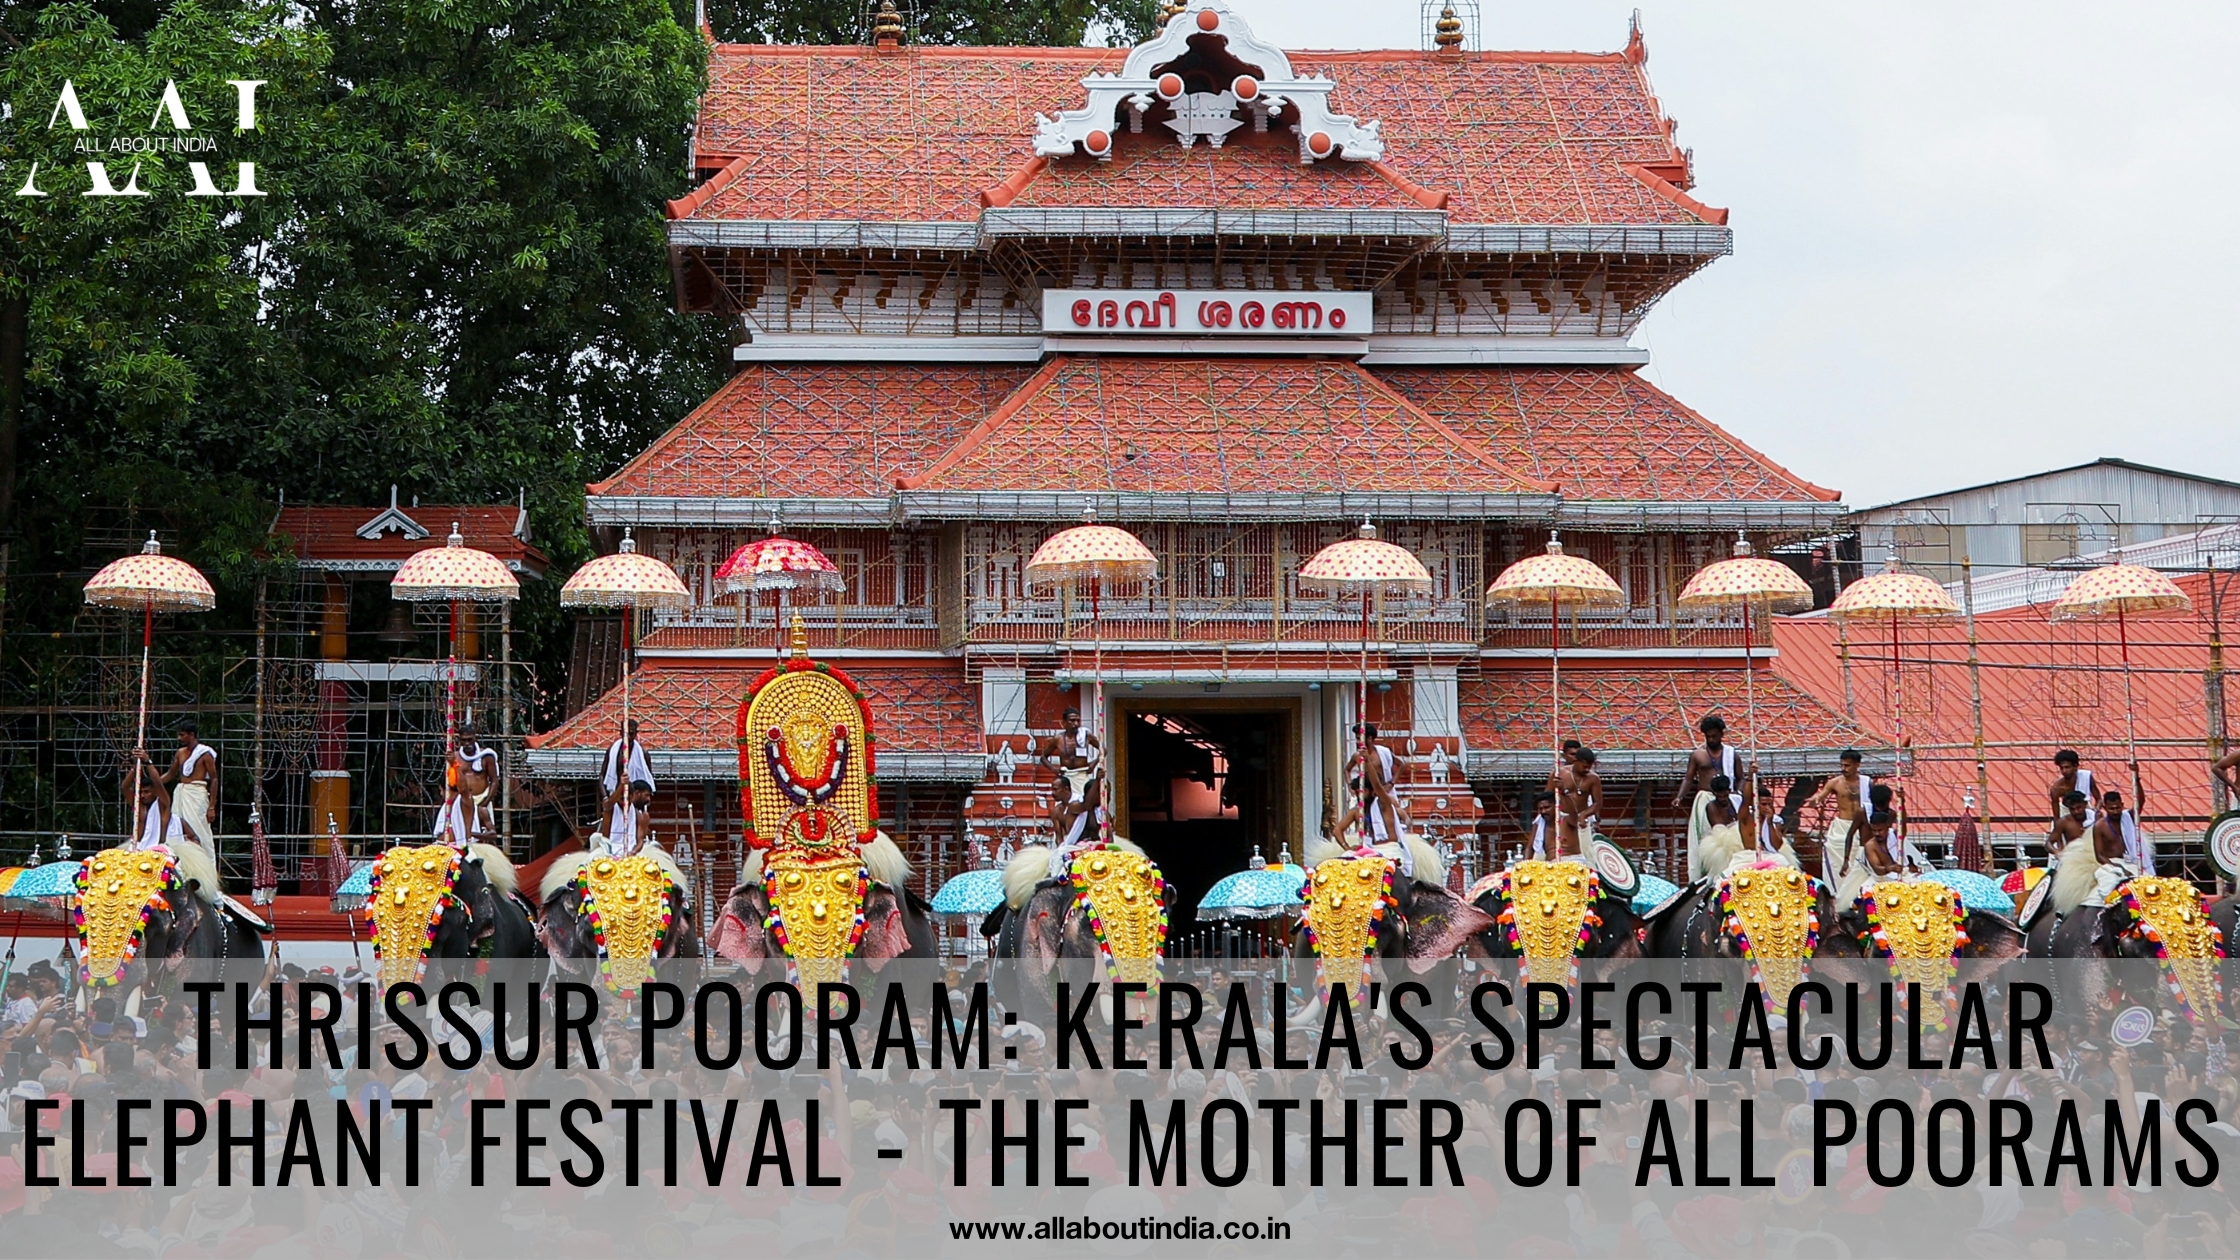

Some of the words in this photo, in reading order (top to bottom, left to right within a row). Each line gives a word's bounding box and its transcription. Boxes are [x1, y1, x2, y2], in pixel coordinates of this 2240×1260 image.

[1071, 291, 1177, 328] ദേവീ
[1198, 300, 1348, 329] ശരണം
[335, 1216, 354, 1236] LG
